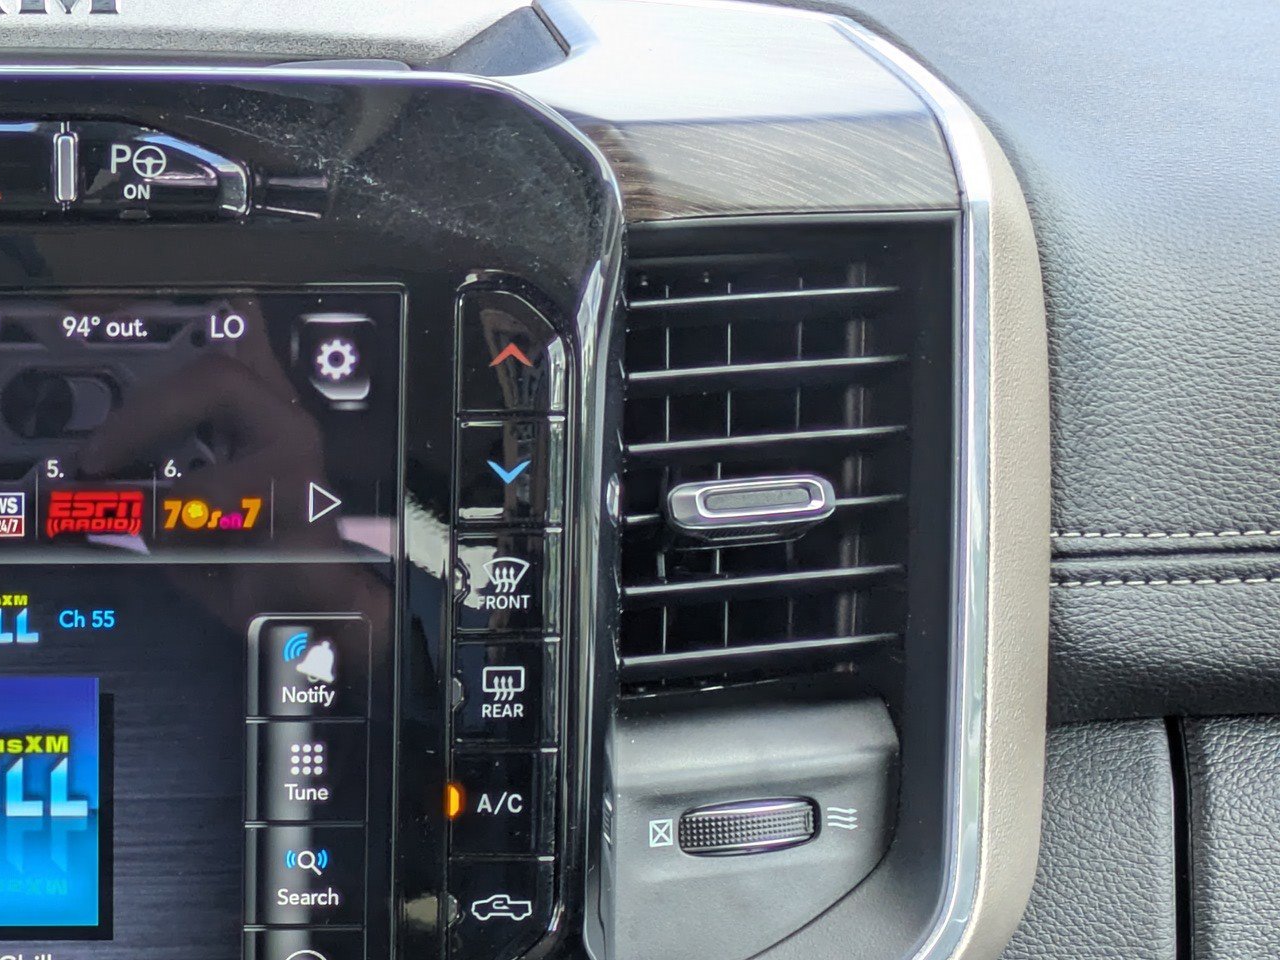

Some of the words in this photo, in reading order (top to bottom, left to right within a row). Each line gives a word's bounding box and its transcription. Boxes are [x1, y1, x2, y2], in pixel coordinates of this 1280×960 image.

[124, 183, 151, 200] ON
[62, 316, 101, 338] 94°
[106, 317, 148, 338] out.
[211, 315, 245, 339] LO
[46, 460, 64, 479] 5.
[164, 459, 182, 478] 6.
[477, 595, 531, 610] FRONT
[58, 610, 87, 628] Ch
[91, 610, 115, 628] 55
[281, 685, 335, 706] Notify
[481, 703, 524, 718] REAR
[284, 784, 329, 802] Tune
[476, 793, 523, 814] A/C
[277, 888, 340, 906] Search
